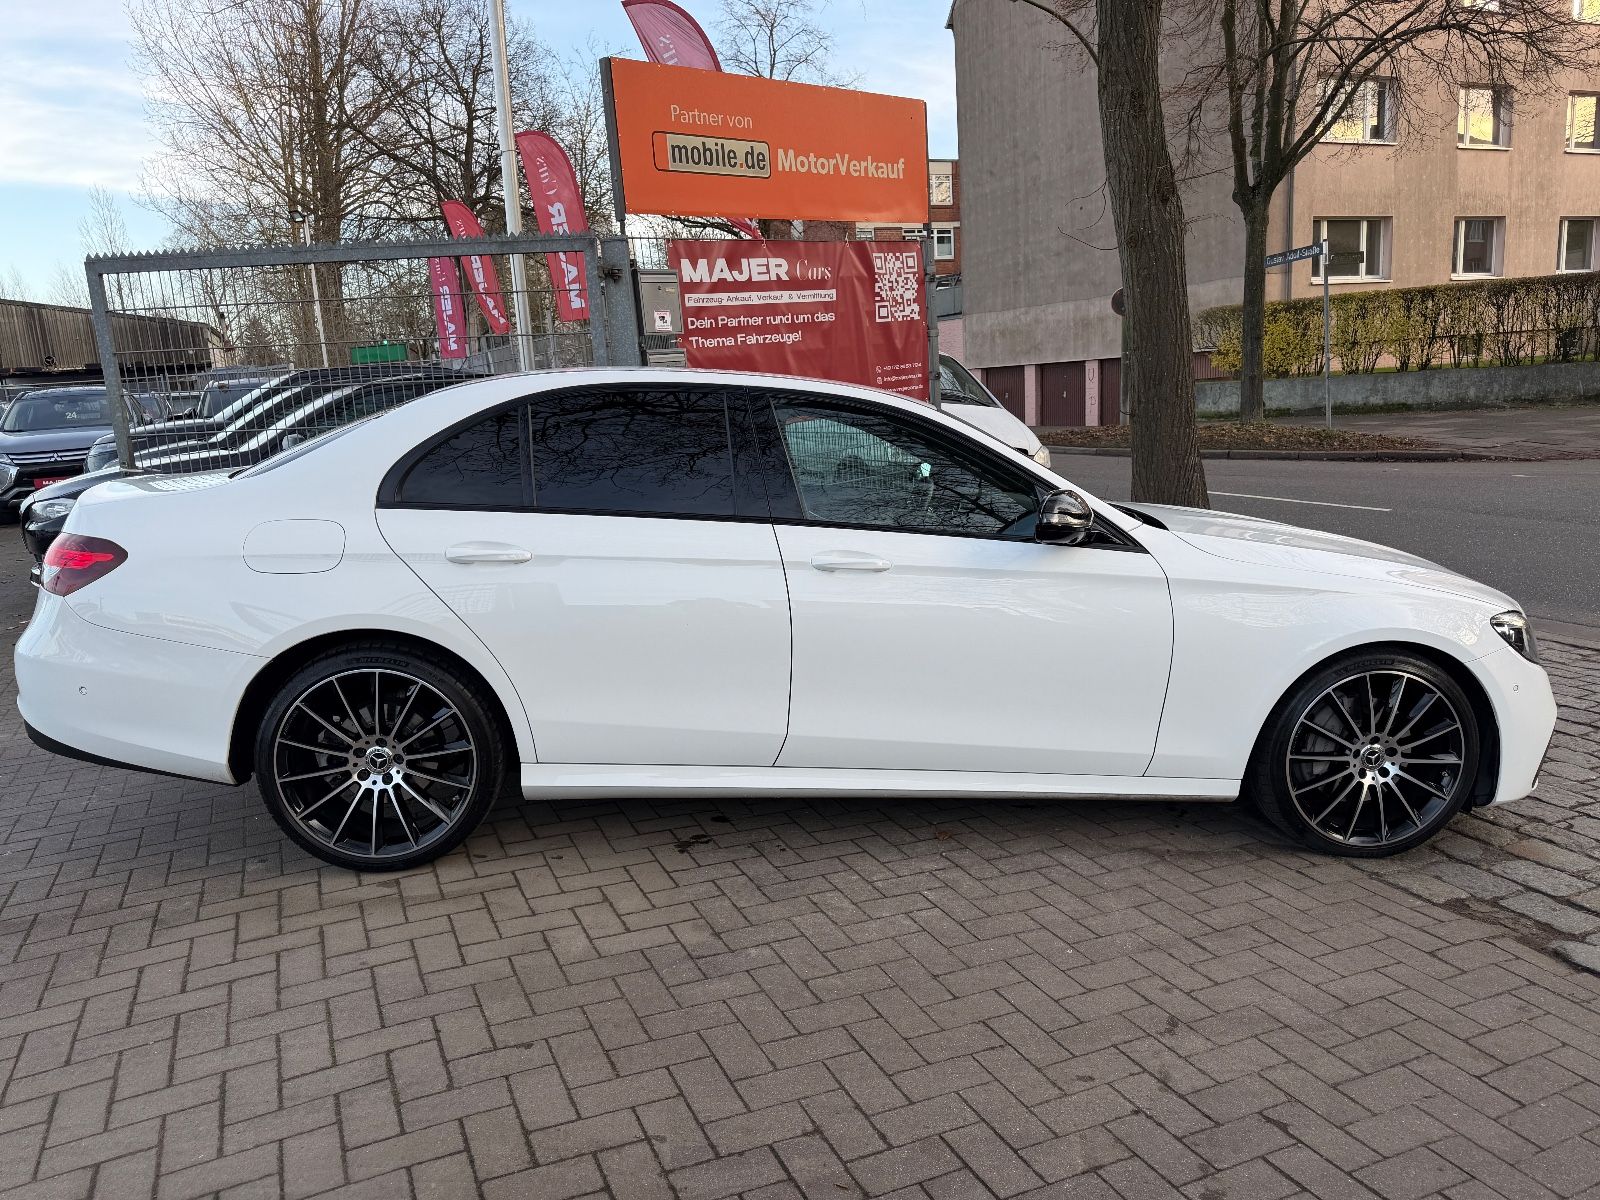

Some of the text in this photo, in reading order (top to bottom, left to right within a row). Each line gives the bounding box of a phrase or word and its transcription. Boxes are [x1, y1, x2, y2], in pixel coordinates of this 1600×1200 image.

[670, 104, 753, 129] Partner von
[670, 140, 905, 180] mobile.de MotorVerkauf
[680, 257, 832, 283] MAJER Cars
[756, 293, 784, 301] Verkauf
[788, 292, 794, 300] &
[687, 311, 836, 330] Dein Partner rund um das
[689, 330, 803, 349] Thema Fahrzeuge!
